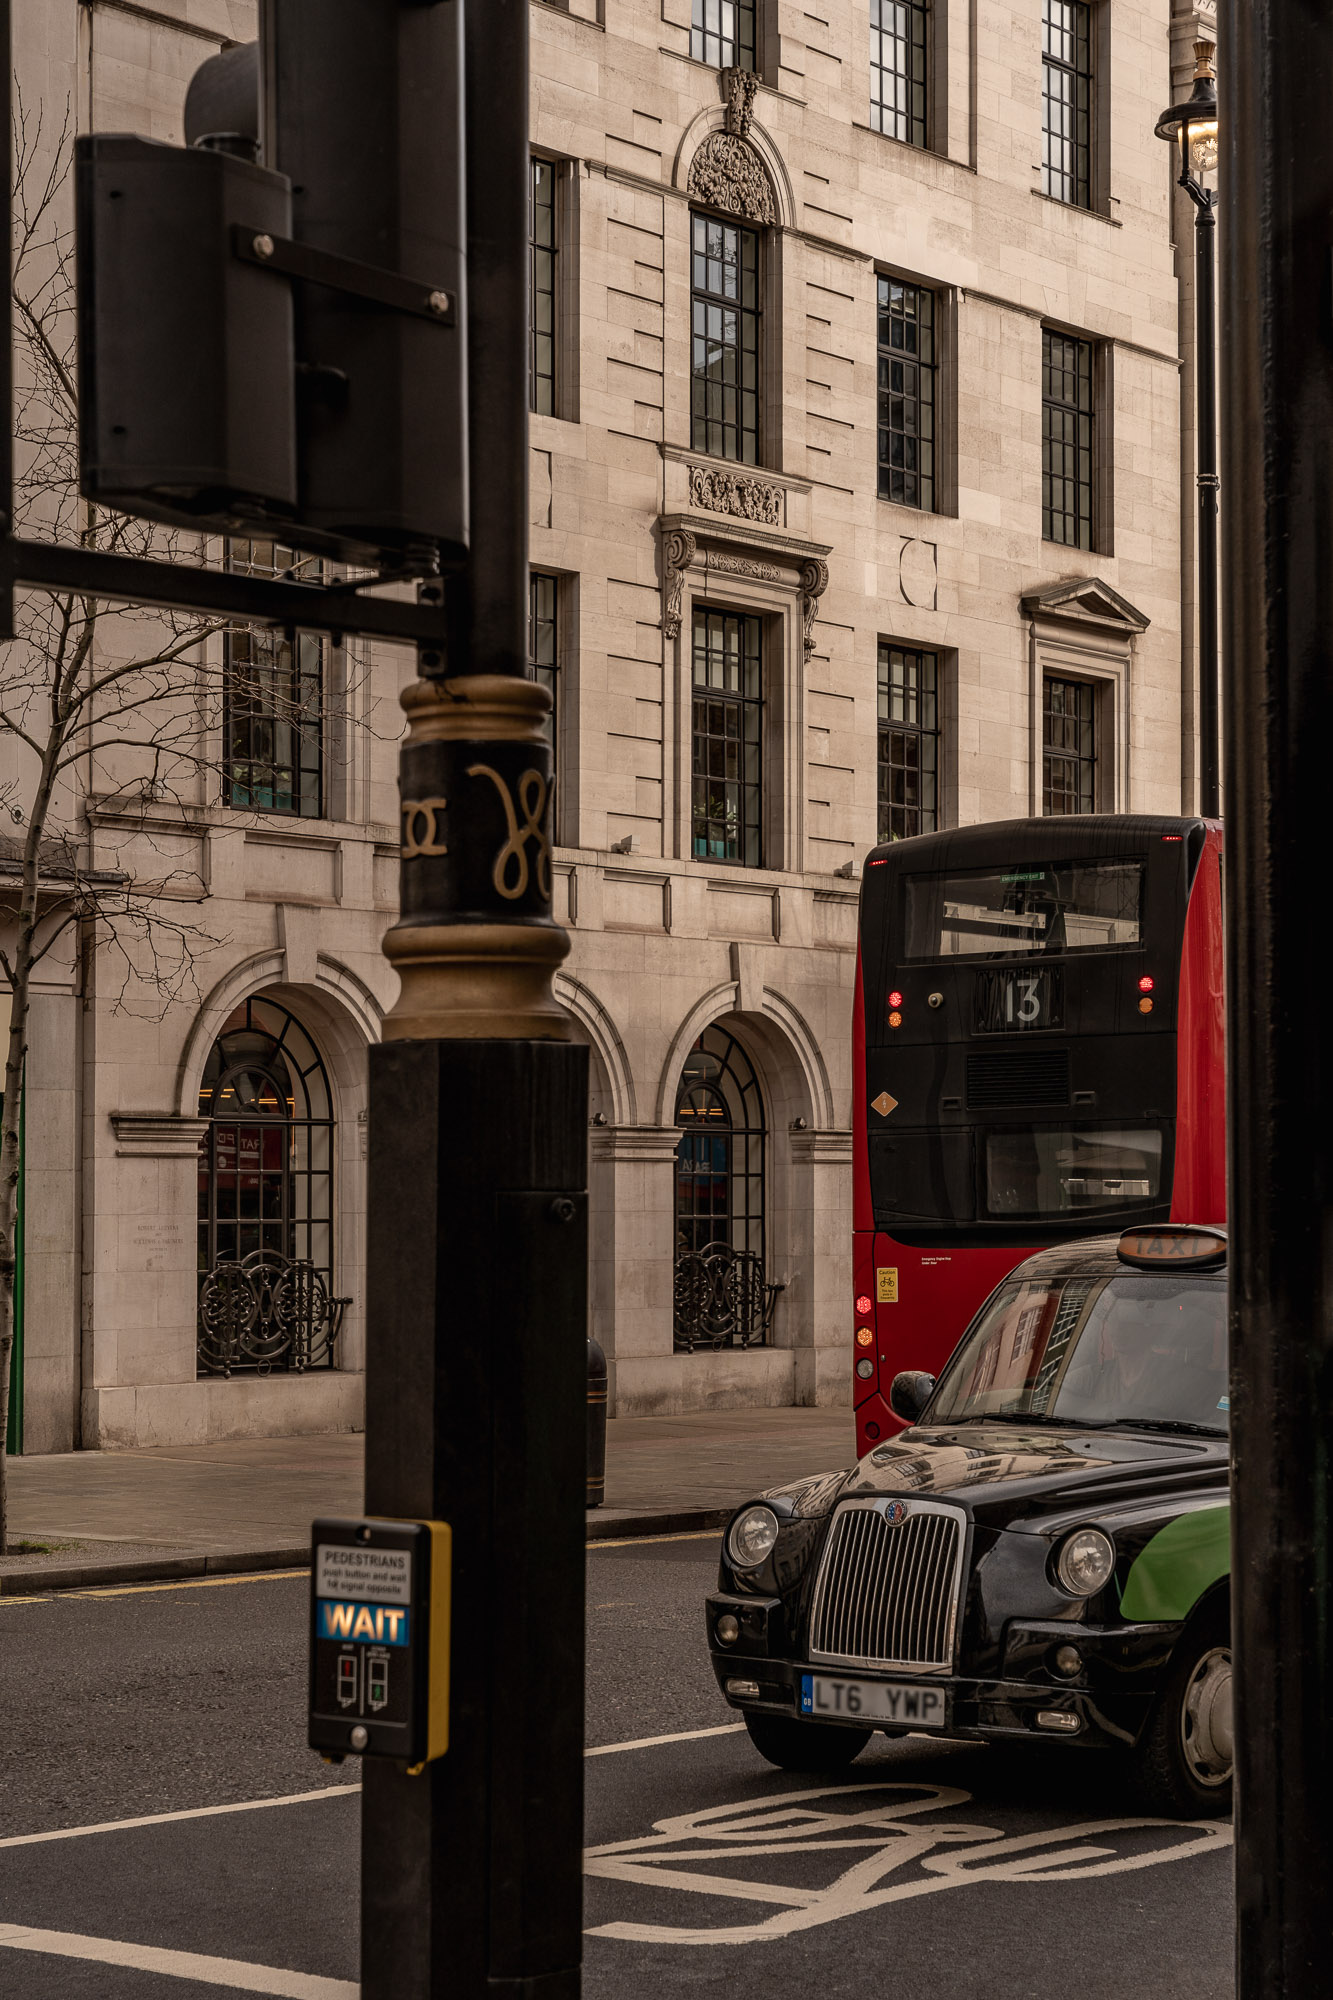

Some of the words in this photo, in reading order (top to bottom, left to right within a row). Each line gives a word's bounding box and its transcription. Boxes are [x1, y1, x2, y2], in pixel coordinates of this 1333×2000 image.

[1006, 978, 1040, 1022] 13
[1136, 1236, 1199, 1256] TAXI
[325, 1550, 405, 1569] PEDESTRIANS
[323, 1568, 343, 1578] push
[344, 1569, 370, 1579] button
[372, 1571, 388, 1580] and
[390, 1572, 407, 1582] wait
[340, 1582, 365, 1592] signal
[366, 1584, 402, 1594] opposite
[324, 1604, 405, 1642] WAIT
[803, 1697, 812, 1706] GB
[885, 1687, 939, 1720] YWP
